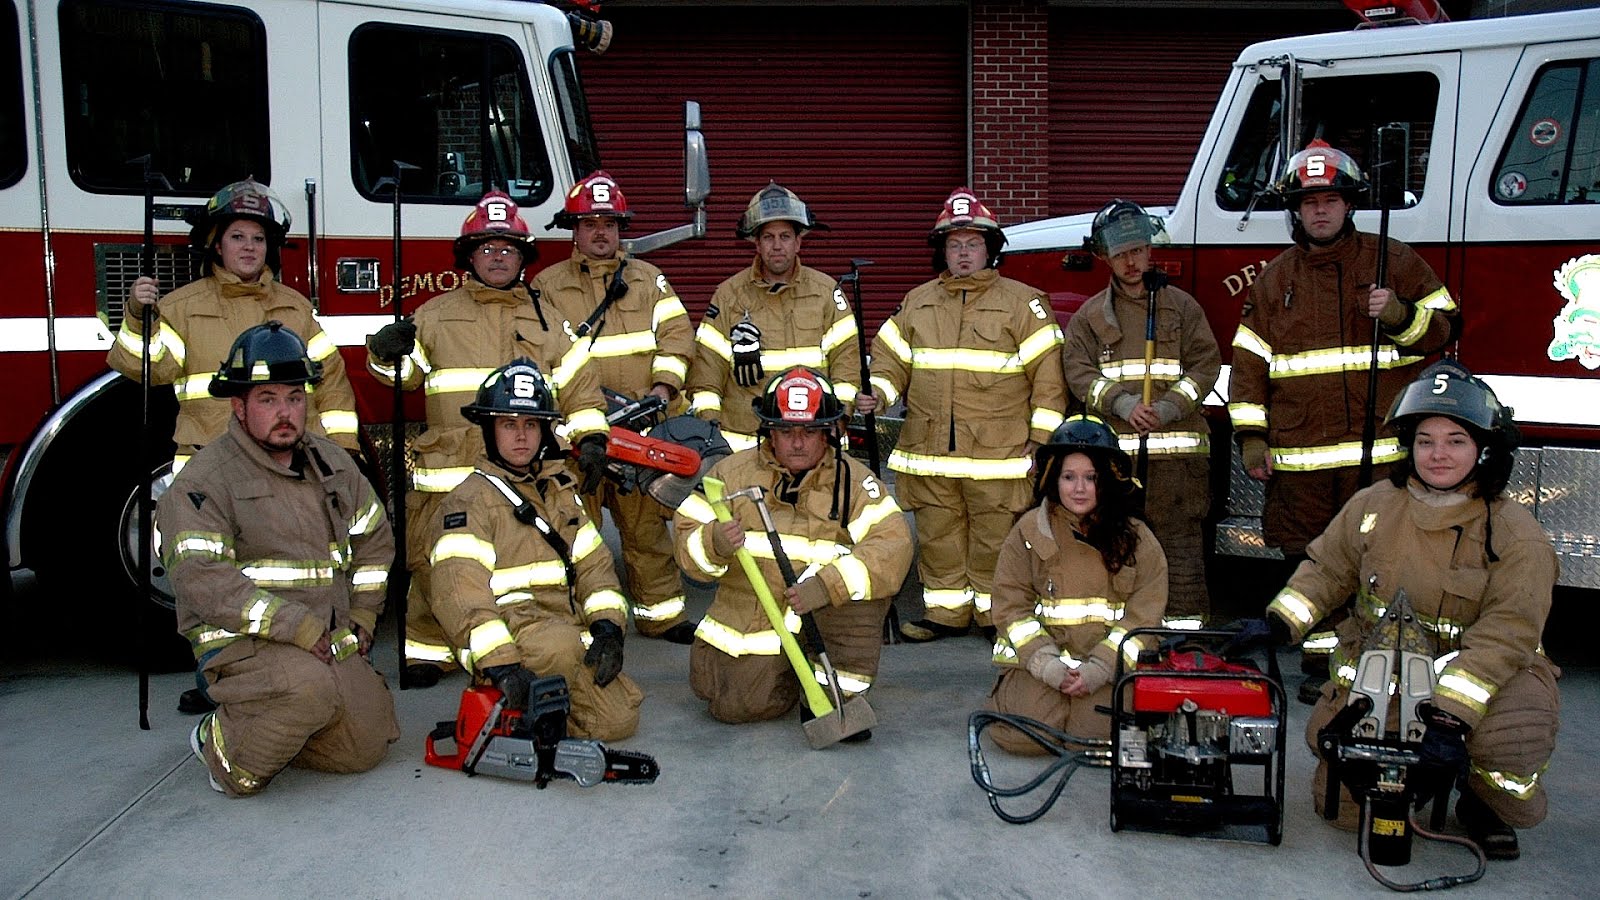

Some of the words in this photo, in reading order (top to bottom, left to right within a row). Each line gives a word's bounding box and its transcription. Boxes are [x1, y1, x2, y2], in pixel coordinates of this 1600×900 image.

[1306, 155, 1326, 177] 5
[592, 184, 610, 203] 5
[487, 203, 507, 221] 5
[952, 198, 970, 216] 5
[1222, 260, 1268, 297] DE
[1028, 298, 1048, 319] 5
[513, 374, 535, 398] 5
[1432, 373, 1450, 395] 5
[862, 475, 881, 499] 5
